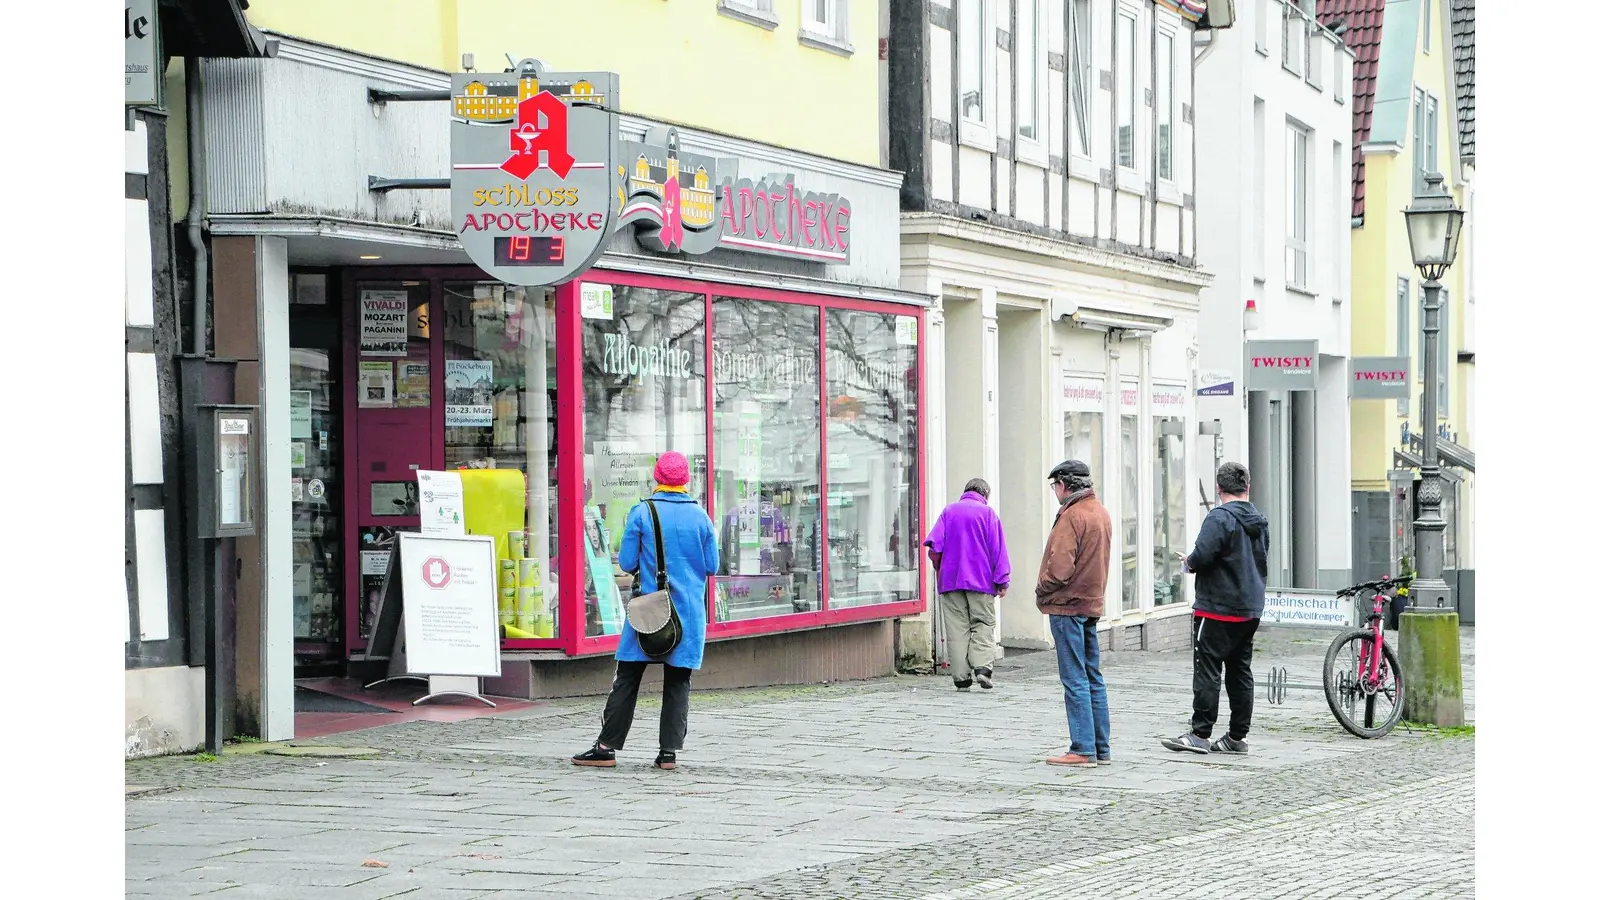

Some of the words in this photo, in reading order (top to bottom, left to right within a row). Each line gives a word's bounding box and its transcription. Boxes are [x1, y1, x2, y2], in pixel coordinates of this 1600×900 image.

[508, 235, 531, 261] 19
[549, 235, 565, 261] 3
[364, 300, 406, 310] VIVALDI
[364, 313, 405, 321] MOZART
[364, 326, 405, 334] PAGANINI
[603, 333, 691, 386] Allopathie
[1251, 356, 1313, 368] TWISTY
[1354, 372, 1406, 381] TWISTY
